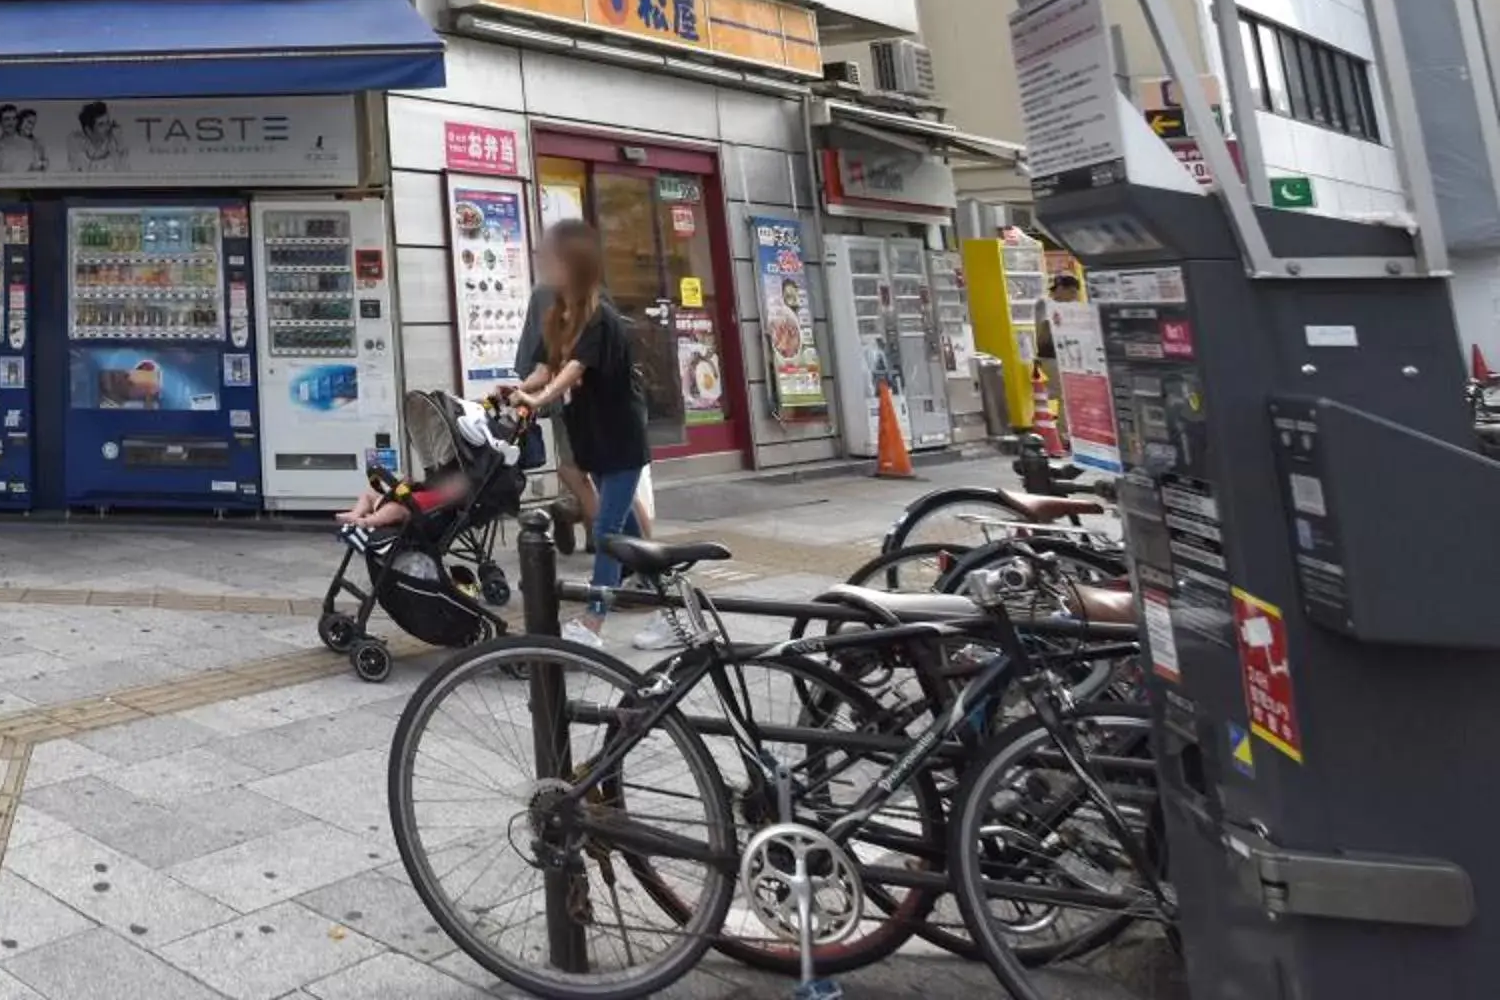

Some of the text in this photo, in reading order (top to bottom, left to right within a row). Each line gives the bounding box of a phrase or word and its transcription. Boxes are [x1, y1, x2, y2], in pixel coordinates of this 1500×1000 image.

[134, 115, 289, 142] TASTE
[468, 130, 514, 164] お弁当
